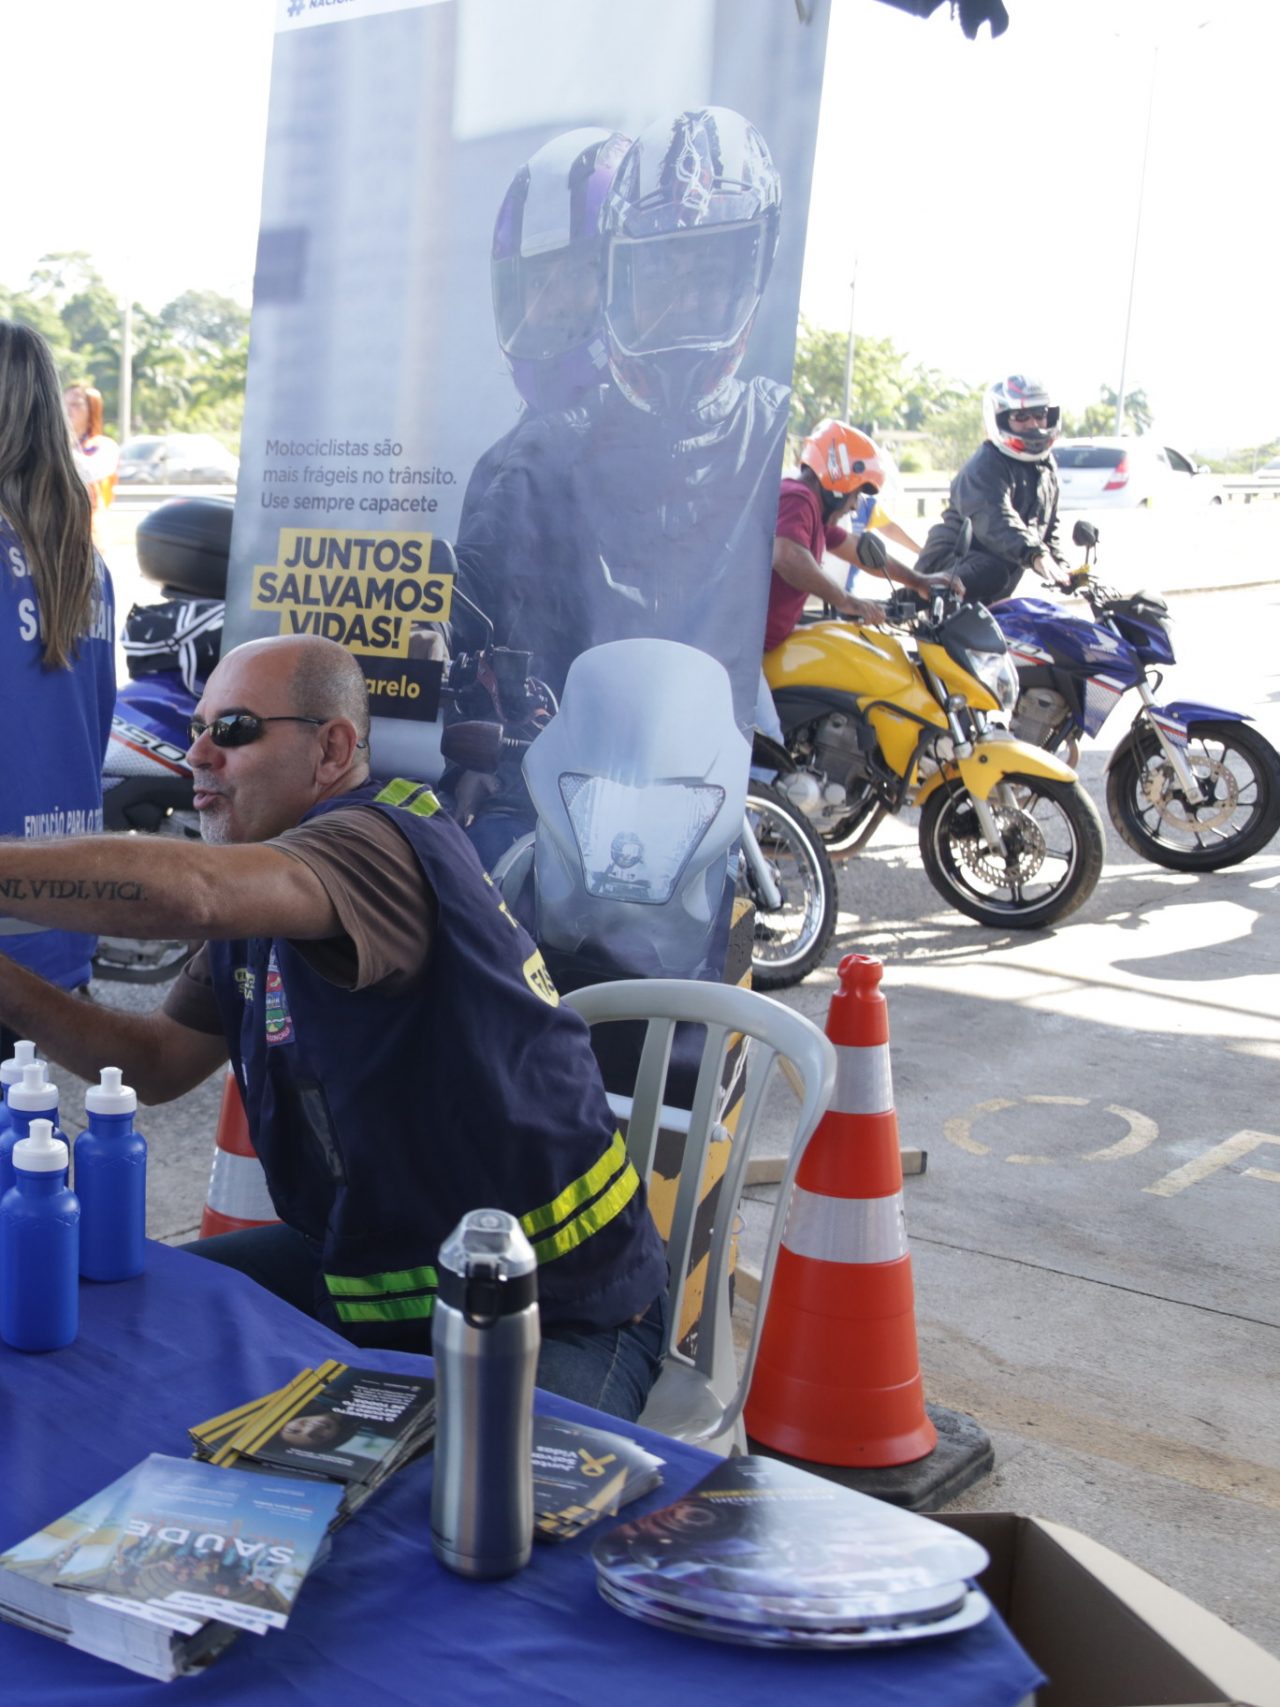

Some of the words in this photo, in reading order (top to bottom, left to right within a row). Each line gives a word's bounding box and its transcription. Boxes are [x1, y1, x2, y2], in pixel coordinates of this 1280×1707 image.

[265, 439, 369, 457] Motociclistas
[373, 438, 403, 457] são
[263, 466, 299, 484] mais
[303, 466, 359, 488] frágeis
[362, 471, 384, 484] no
[389, 466, 457, 485] trânsito.
[260, 492, 290, 509] Use
[293, 494, 354, 512] sempre
[359, 496, 438, 515] capacete
[284, 537, 422, 573] JUNTOS
[257, 572, 444, 613] SALVAMOS
[289, 610, 402, 649] VIDAS!
[367, 675, 420, 699] arelo
[531, 1452, 577, 1466] Salva
[535, 1445, 579, 1459] Vidas
[123, 1517, 295, 1565] SAÚDE
